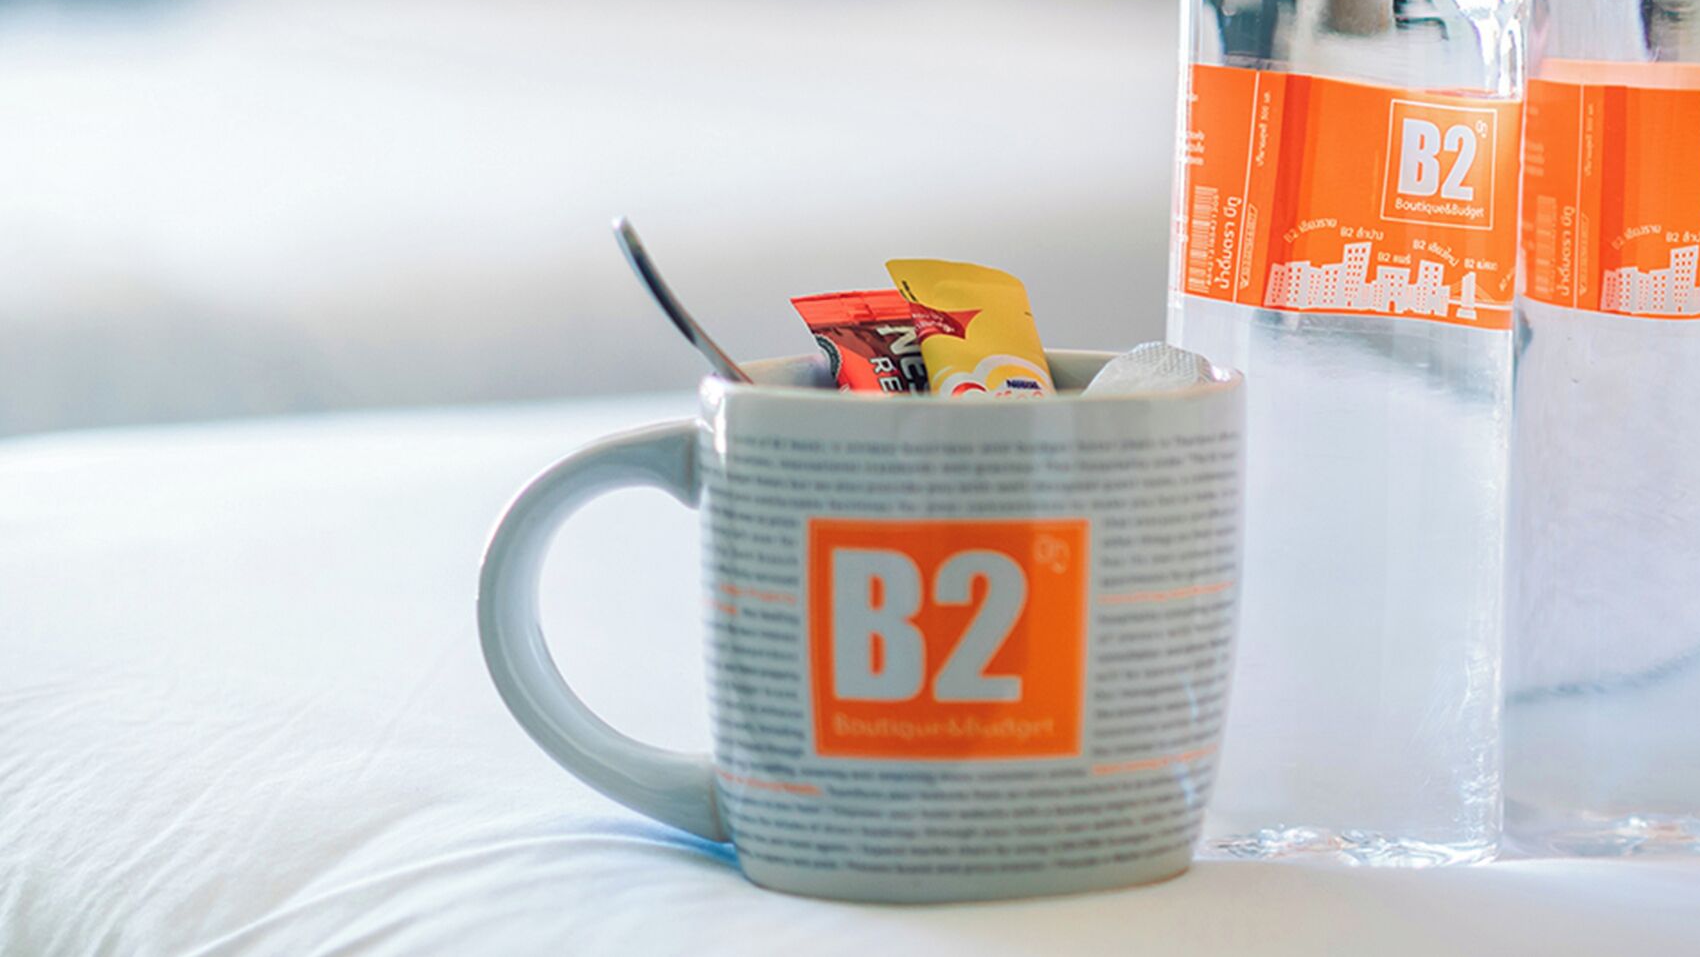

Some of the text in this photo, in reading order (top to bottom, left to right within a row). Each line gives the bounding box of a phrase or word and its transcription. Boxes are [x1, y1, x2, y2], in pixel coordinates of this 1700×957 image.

[1397, 117, 1478, 201] B2
[1395, 196, 1485, 220] Boutique&Budget
[1340, 226, 1354, 238] B2
[1666, 232, 1679, 243] B2
[1412, 238, 1426, 251] B2
[1377, 250, 1391, 263] B2
[1463, 257, 1475, 269] B2
[876, 325, 930, 397] NE
[831, 547, 1029, 703] B2
[833, 711, 1055, 741] Boutique&Budget
